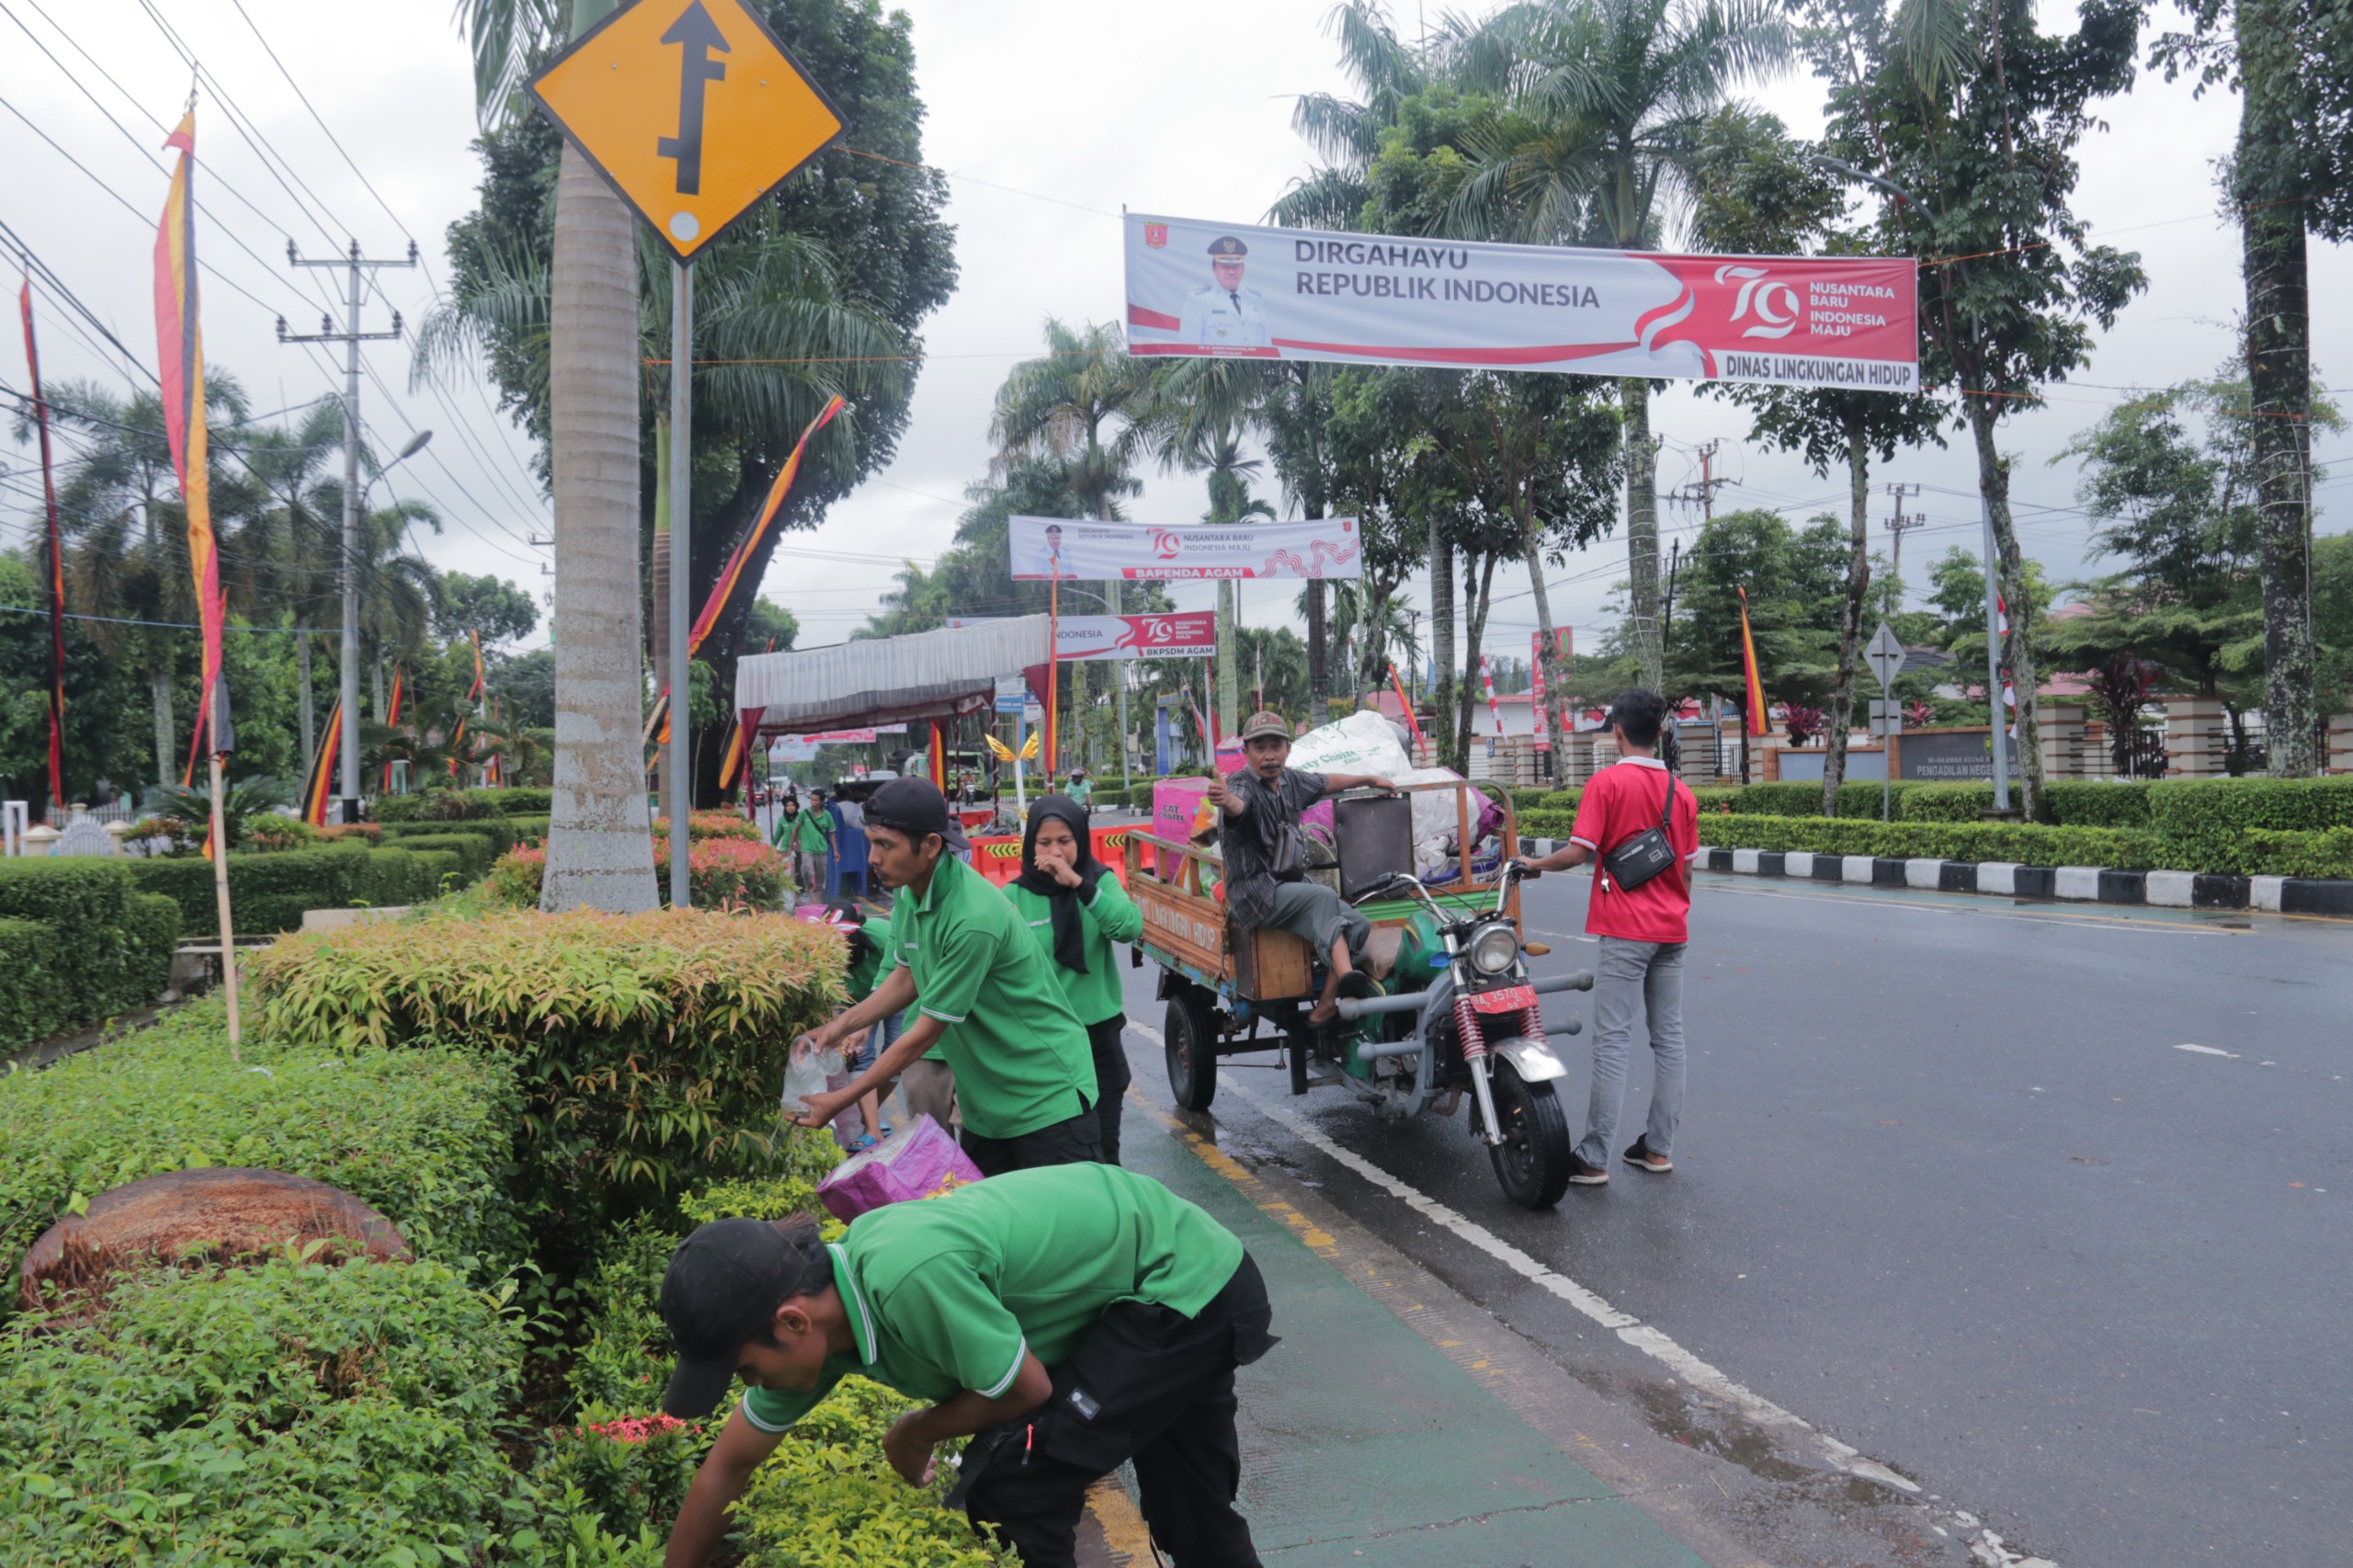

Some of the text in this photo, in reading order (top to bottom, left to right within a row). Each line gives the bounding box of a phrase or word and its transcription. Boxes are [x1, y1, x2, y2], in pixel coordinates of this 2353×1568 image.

[1295, 239, 1468, 270] DIRGAHAYU
[1296, 271, 1600, 309] REPUBLIK INDONESIA
[1810, 281, 1895, 300] NUSANTARA
[1810, 294, 1848, 308] BARU
[1810, 310, 1886, 326] INDONESIA
[1810, 323, 1851, 336] MAJU
[1726, 355, 1911, 386] DINAS LINGKUNGAN HIDUP
[1183, 534, 1254, 542] NUSANTARA BARU
[1135, 568, 1244, 578] BAPENDA AGAM
[1051, 629, 1103, 640] NDONESIA
[1146, 647, 1185, 656] BKPSDM
[1916, 765, 1969, 777] PENGADILAN
[1969, 765, 1994, 776] NEGE
[1163, 804, 1179, 813] CAT
[1158, 812, 1185, 822] CHOIZE
[1152, 903, 1192, 941] LINGKUNGAN
[1193, 922, 1215, 951] HIDUP
[1472, 984, 1531, 1006] BA 3570 T
